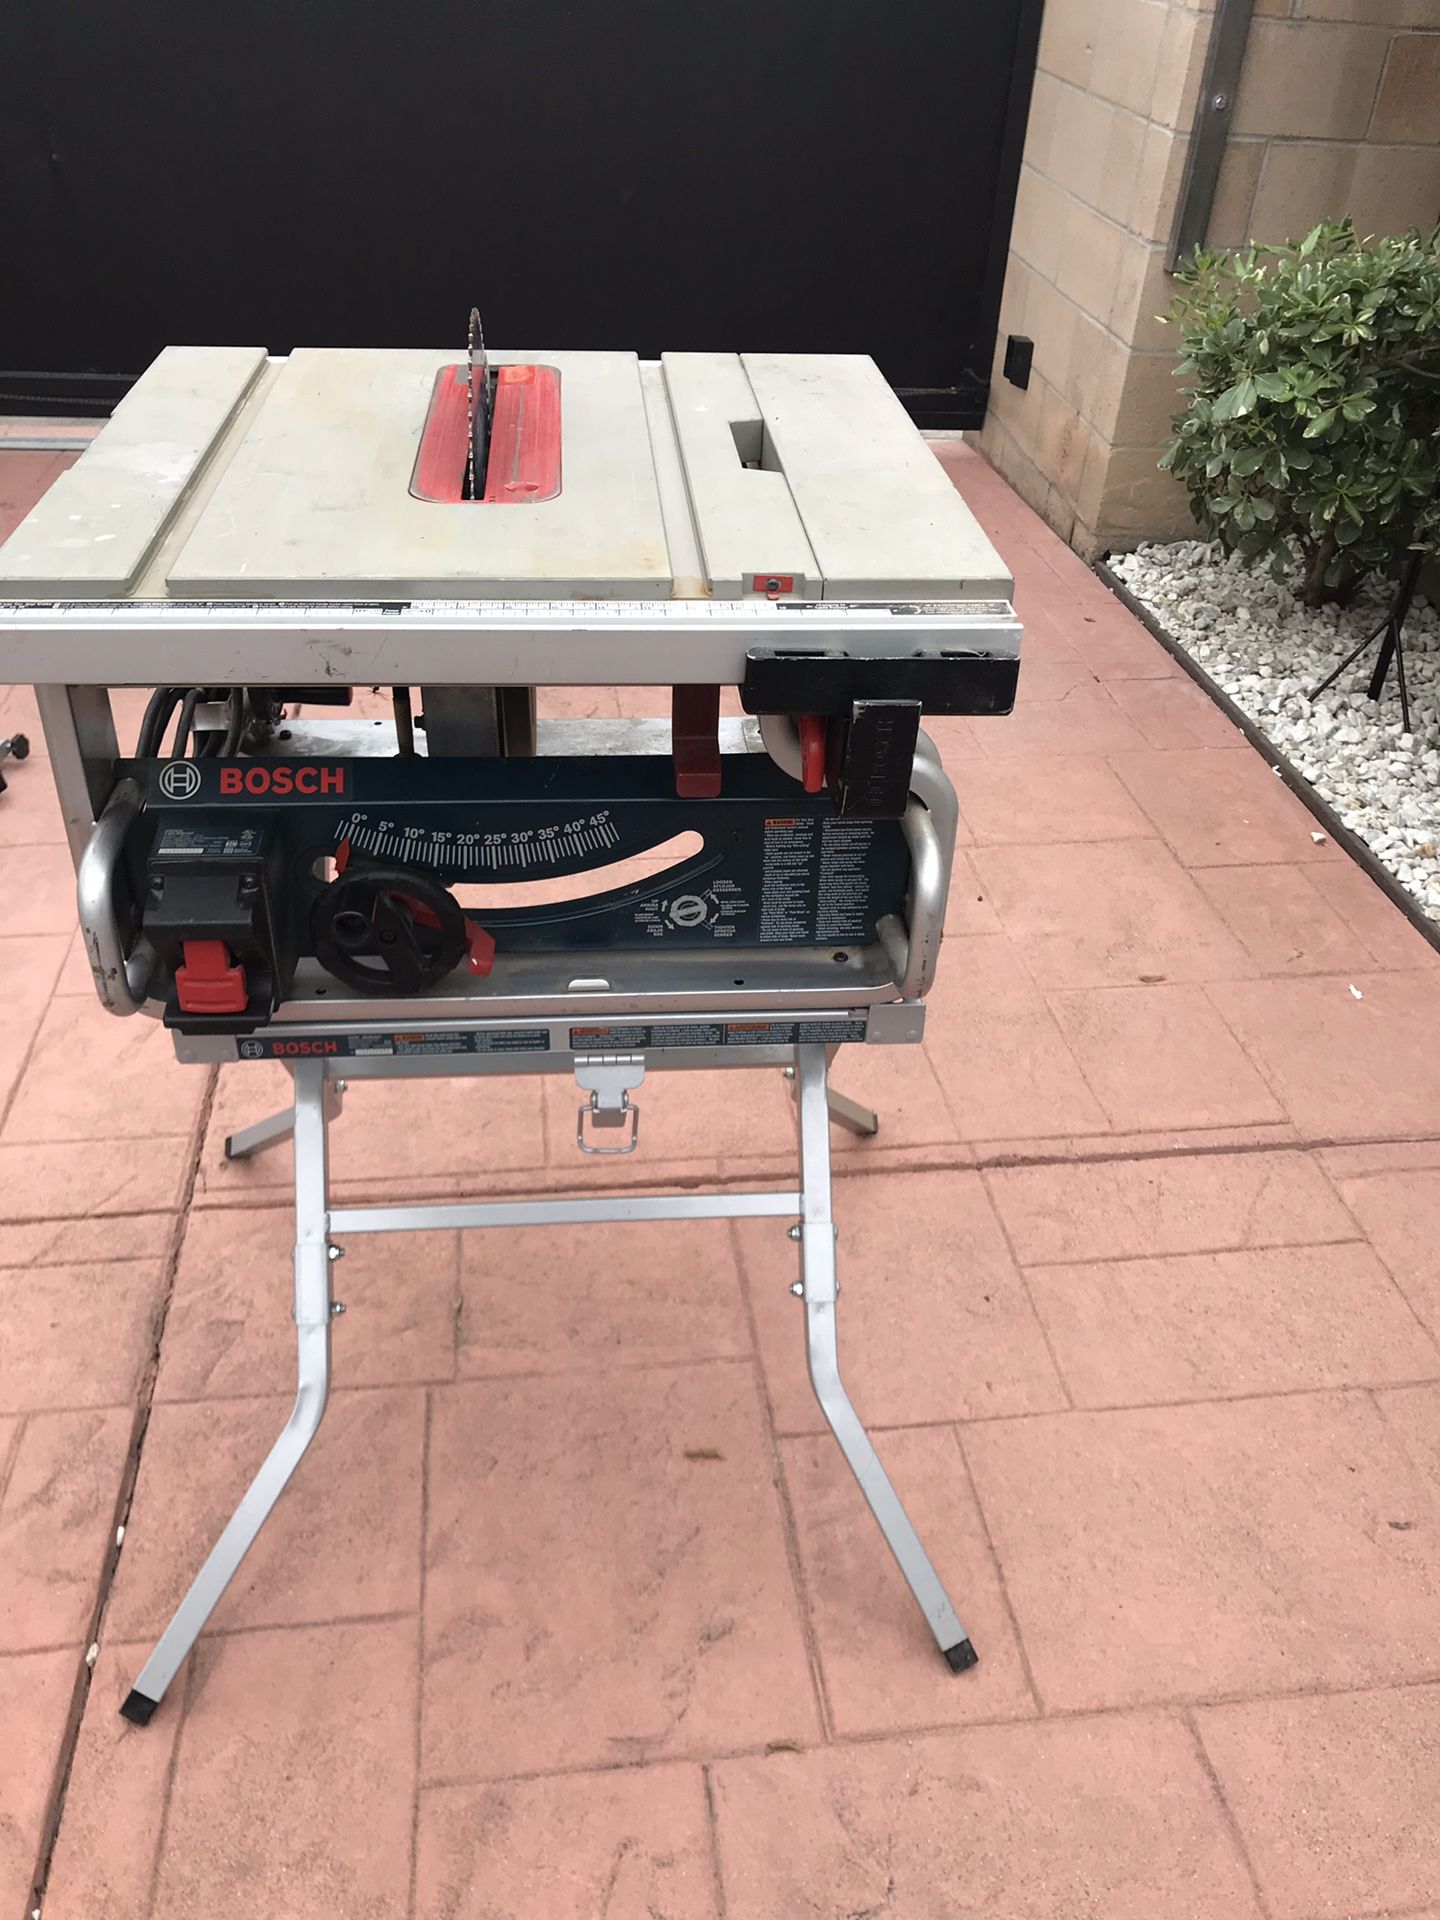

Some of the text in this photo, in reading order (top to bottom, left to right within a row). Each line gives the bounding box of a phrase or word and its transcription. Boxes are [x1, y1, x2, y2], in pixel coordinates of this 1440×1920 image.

[220, 767, 344, 795] BOSCH
[351, 810, 610, 845] 0° 5° 10° 15° 20° 25° 30° 35° 40° 45°
[271, 1040, 338, 1056] BOSCH
